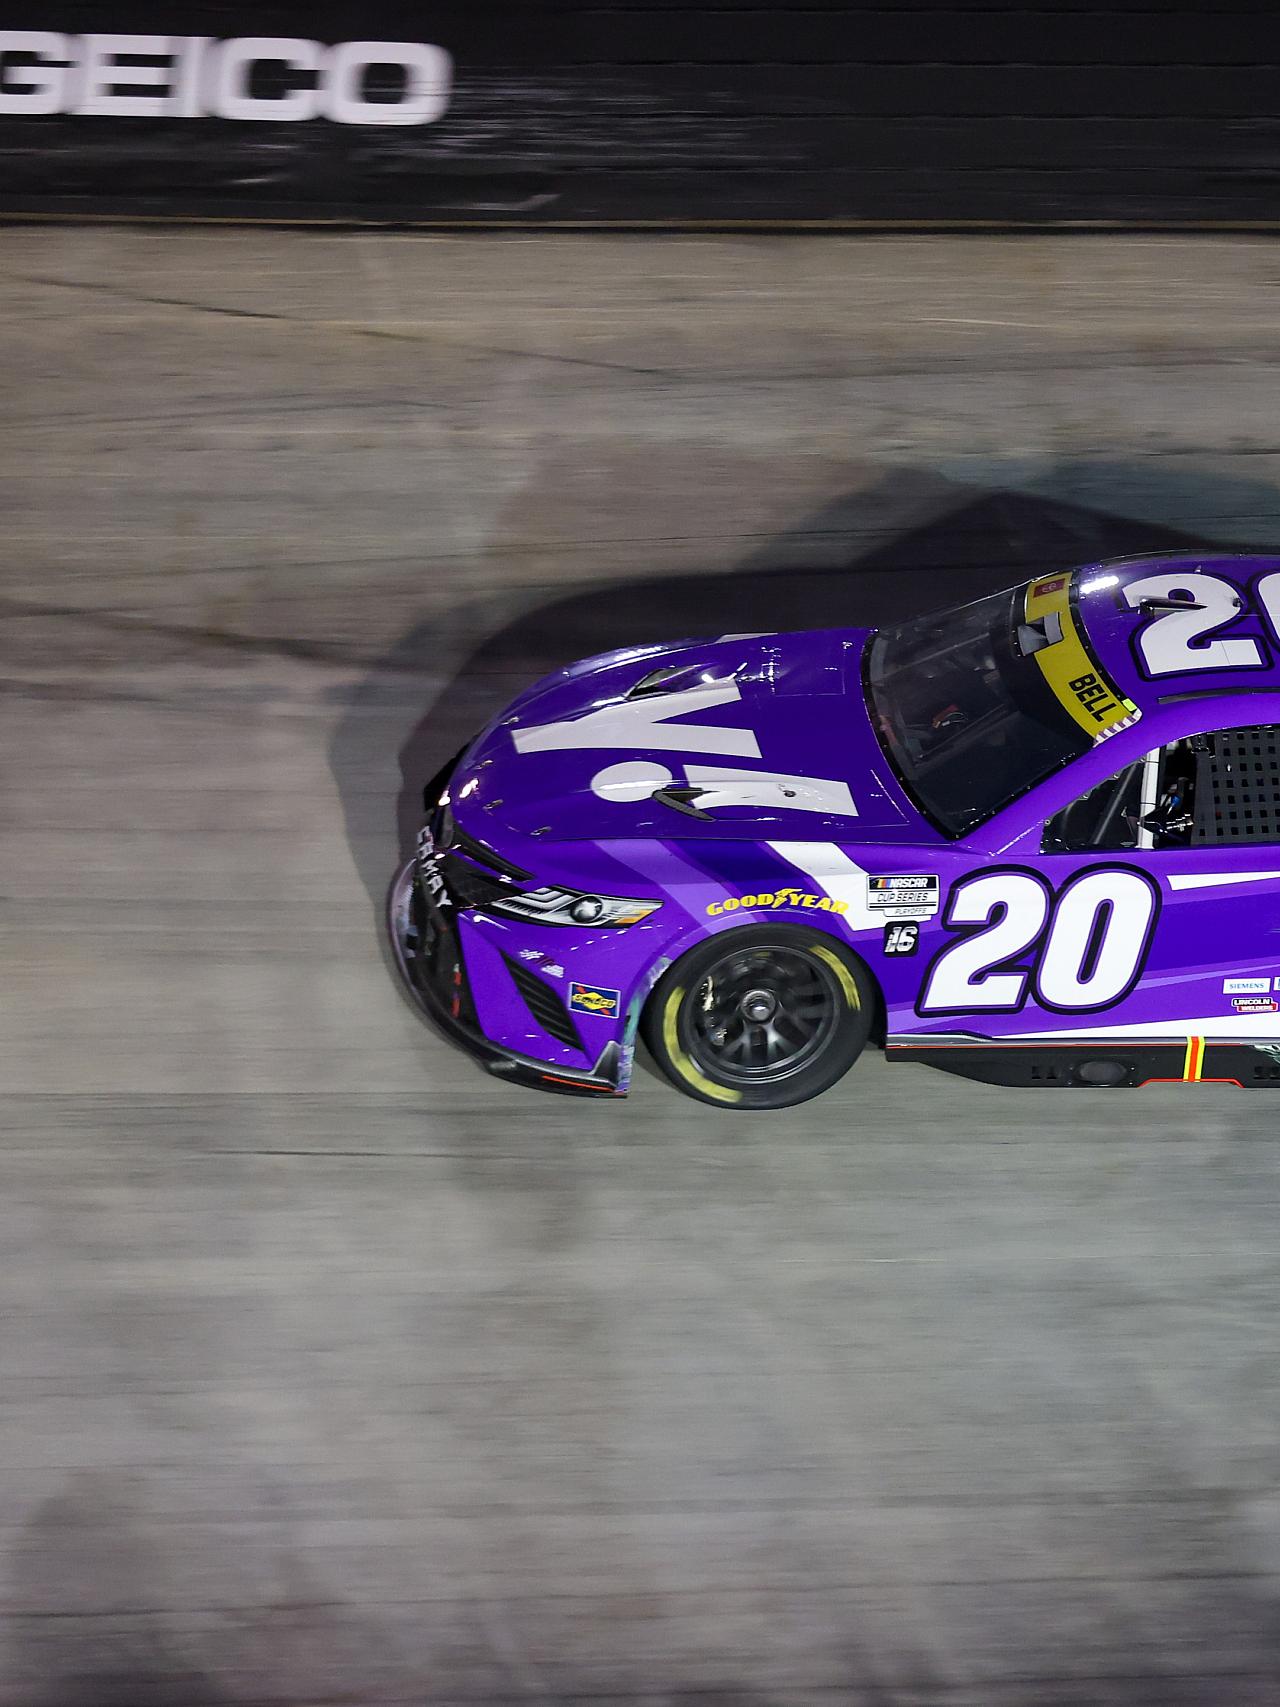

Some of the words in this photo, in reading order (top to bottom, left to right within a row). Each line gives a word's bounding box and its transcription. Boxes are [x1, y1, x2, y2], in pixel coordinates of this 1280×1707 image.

[0, 30, 453, 125] GEICO
[1068, 673, 1118, 722] BELL
[890, 878, 928, 888] NASCAR
[706, 889, 849, 916] GOODYEAR
[877, 893, 895, 902] CUP
[896, 892, 928, 902] SERIES
[884, 926, 918, 952] 16
[919, 868, 1156, 1011] 20
[1229, 982, 1265, 990] SIEMENS
[573, 993, 615, 1008] SUNOCO
